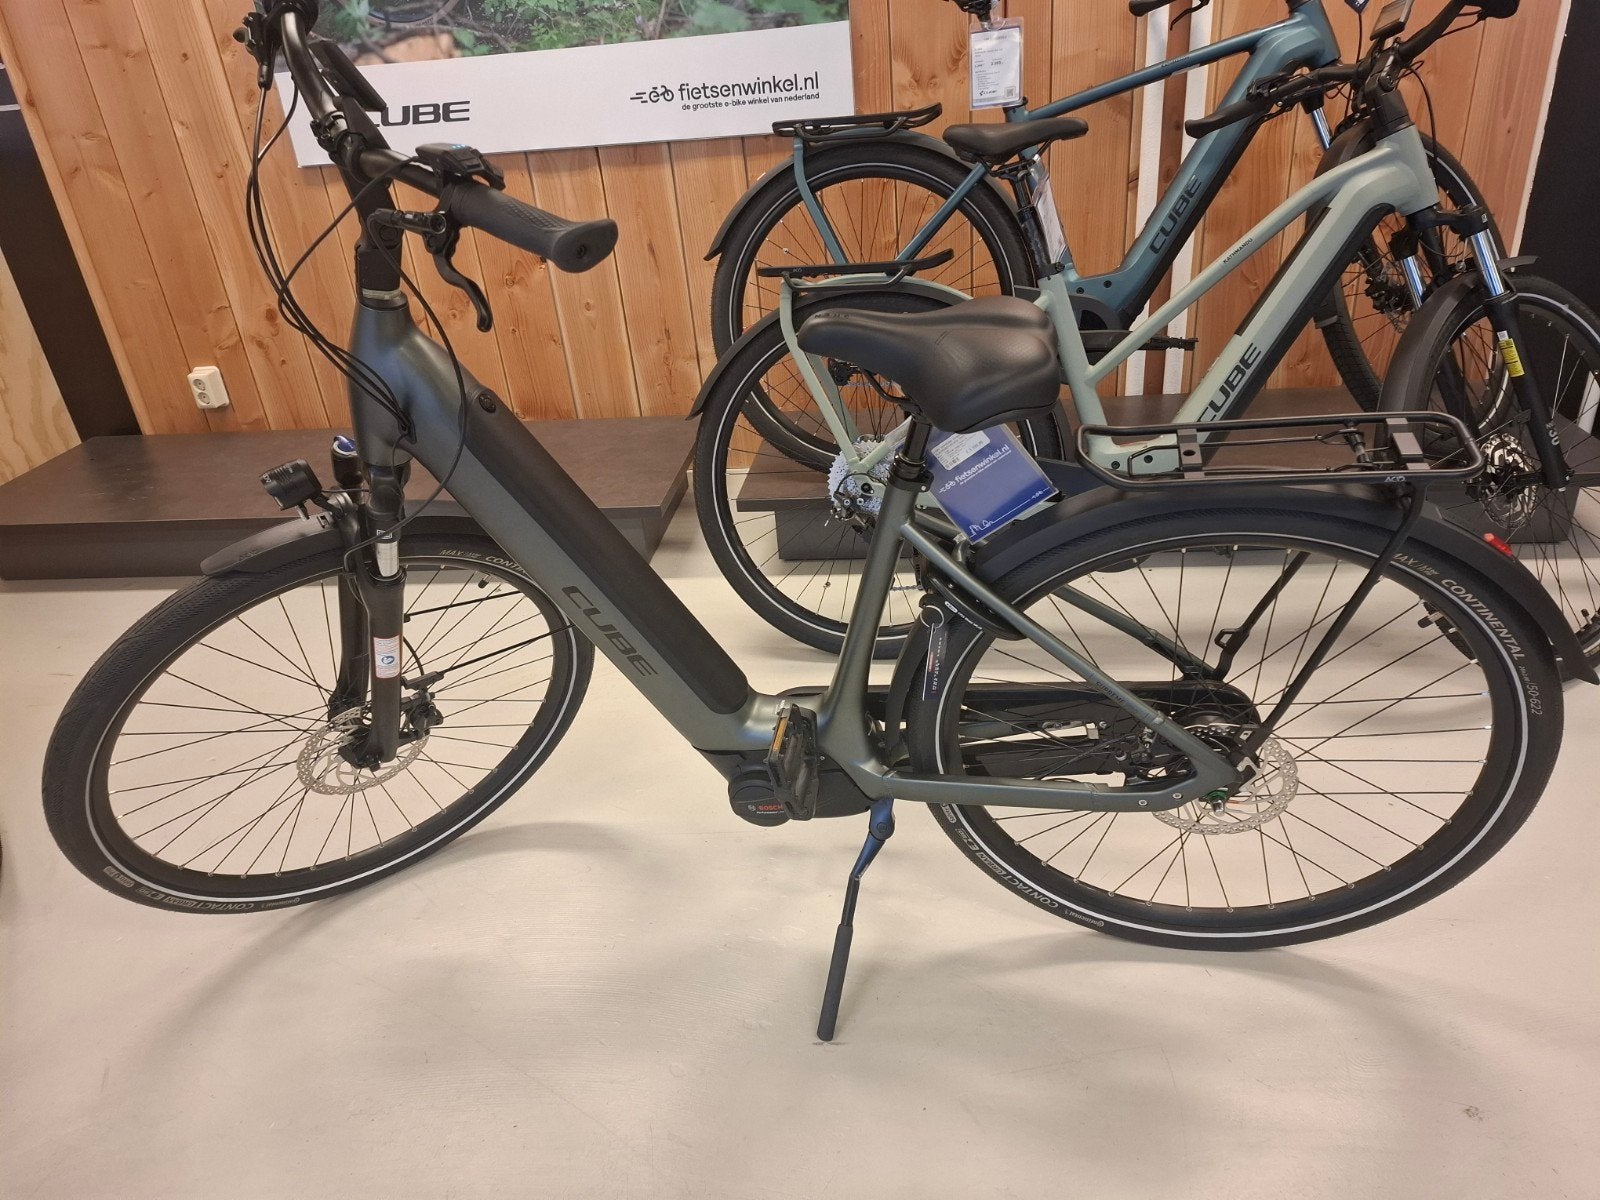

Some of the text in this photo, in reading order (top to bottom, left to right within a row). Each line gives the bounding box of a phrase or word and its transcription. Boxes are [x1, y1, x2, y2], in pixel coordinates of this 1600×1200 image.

[678, 71, 819, 101] fietsenwinkel.nl
[681, 103, 692, 111] de
[692, 101, 723, 111] grootste
[724, 99, 747, 107] e-bike
[748, 96, 770, 105] winkel
[784, 92, 820, 102] nederland
[374, 101, 470, 127] UBE
[1149, 178, 1202, 255] CUBE
[1223, 238, 1253, 264] KATHMANDU
[955, 444, 1010, 483] fietsenwinkel.nl
[561, 585, 659, 677] CUBE
[1441, 579, 1525, 661] CONTINENTAL
[199, 902, 255, 911] CONTACT
[1005, 873, 1059, 909] CONTACT
